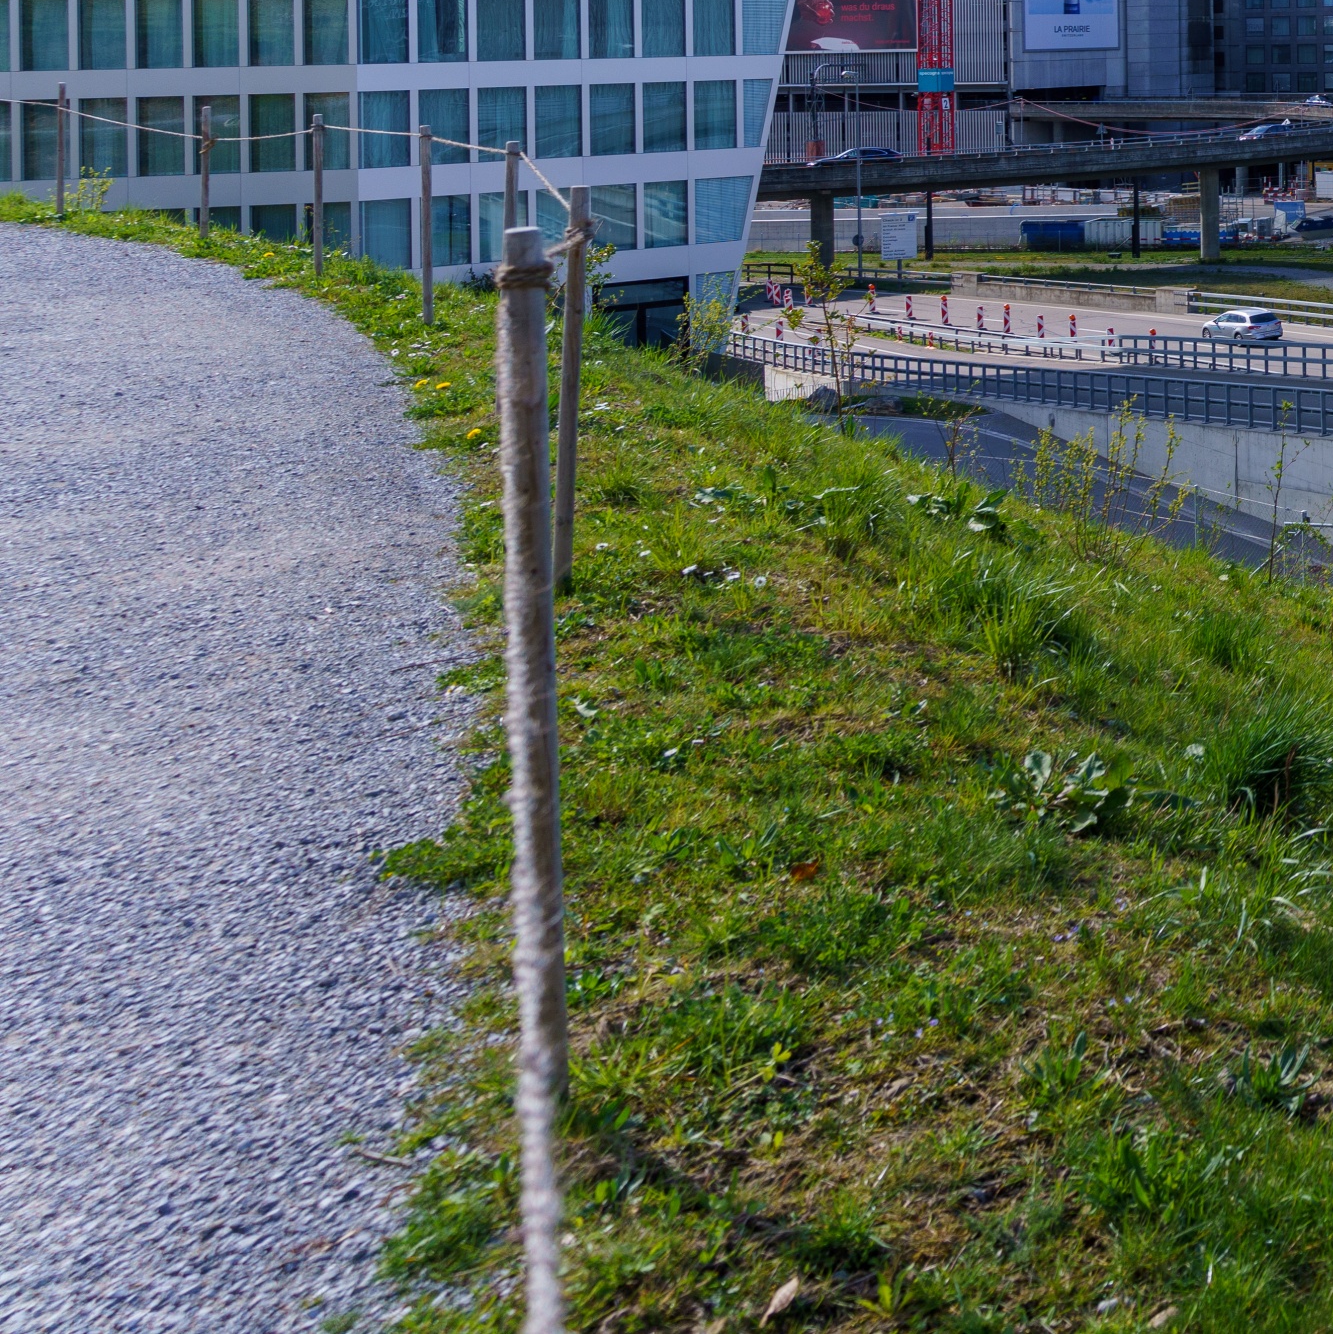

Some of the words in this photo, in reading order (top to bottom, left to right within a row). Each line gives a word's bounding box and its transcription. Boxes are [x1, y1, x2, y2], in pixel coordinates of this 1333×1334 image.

[841, 3, 858, 11] was
[859, 2, 871, 11] du
[872, 2, 896, 11] draus
[841, 13, 874, 21] machst.
[1054, 25, 1063, 33] LA
[1064, 25, 1090, 33] PRAIRIE
[943, 99, 948, 108] 2
